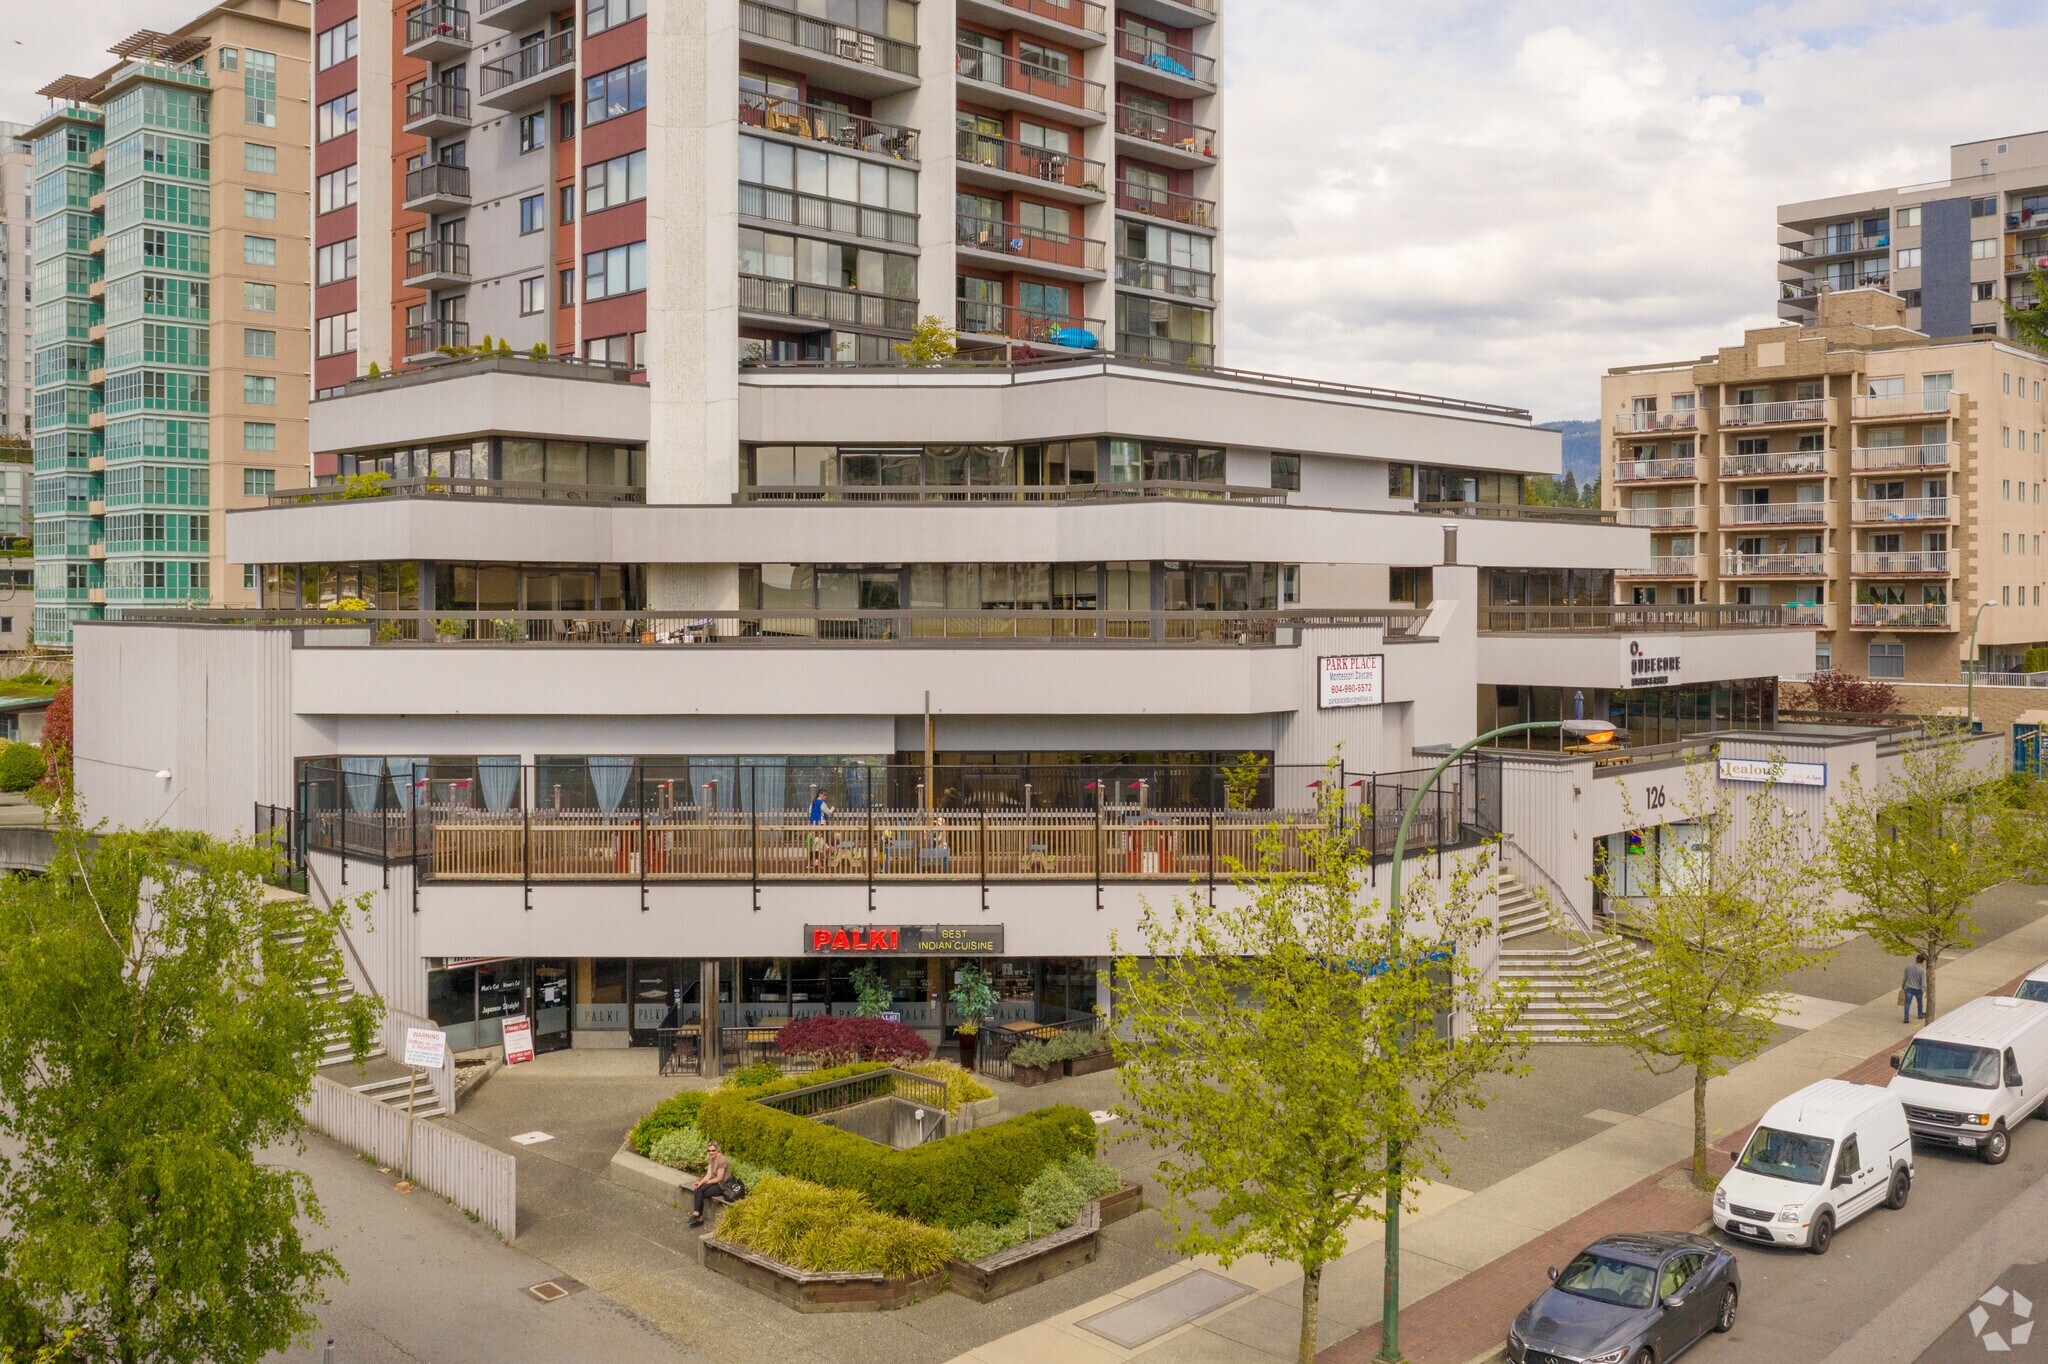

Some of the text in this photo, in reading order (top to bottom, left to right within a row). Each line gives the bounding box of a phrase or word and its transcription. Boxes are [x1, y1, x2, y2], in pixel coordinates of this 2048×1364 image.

[1326, 656, 1376, 670] PARK PLACE
[1330, 670, 1373, 681] Montessori Daycare
[1331, 683, 1372, 693] 604-990-5572
[1722, 762, 1787, 777] Jealousy
[1646, 785, 1665, 810] 126
[942, 929, 967, 938] BEST
[813, 929, 898, 950] PALKI
[918, 941, 993, 950] INDIAN CUISINE
[585, 1010, 619, 1022] PALKI
[638, 1008, 665, 1020] PALKI
[993, 1009, 1026, 1020] PALKI
[412, 1031, 440, 1041] WARNING
